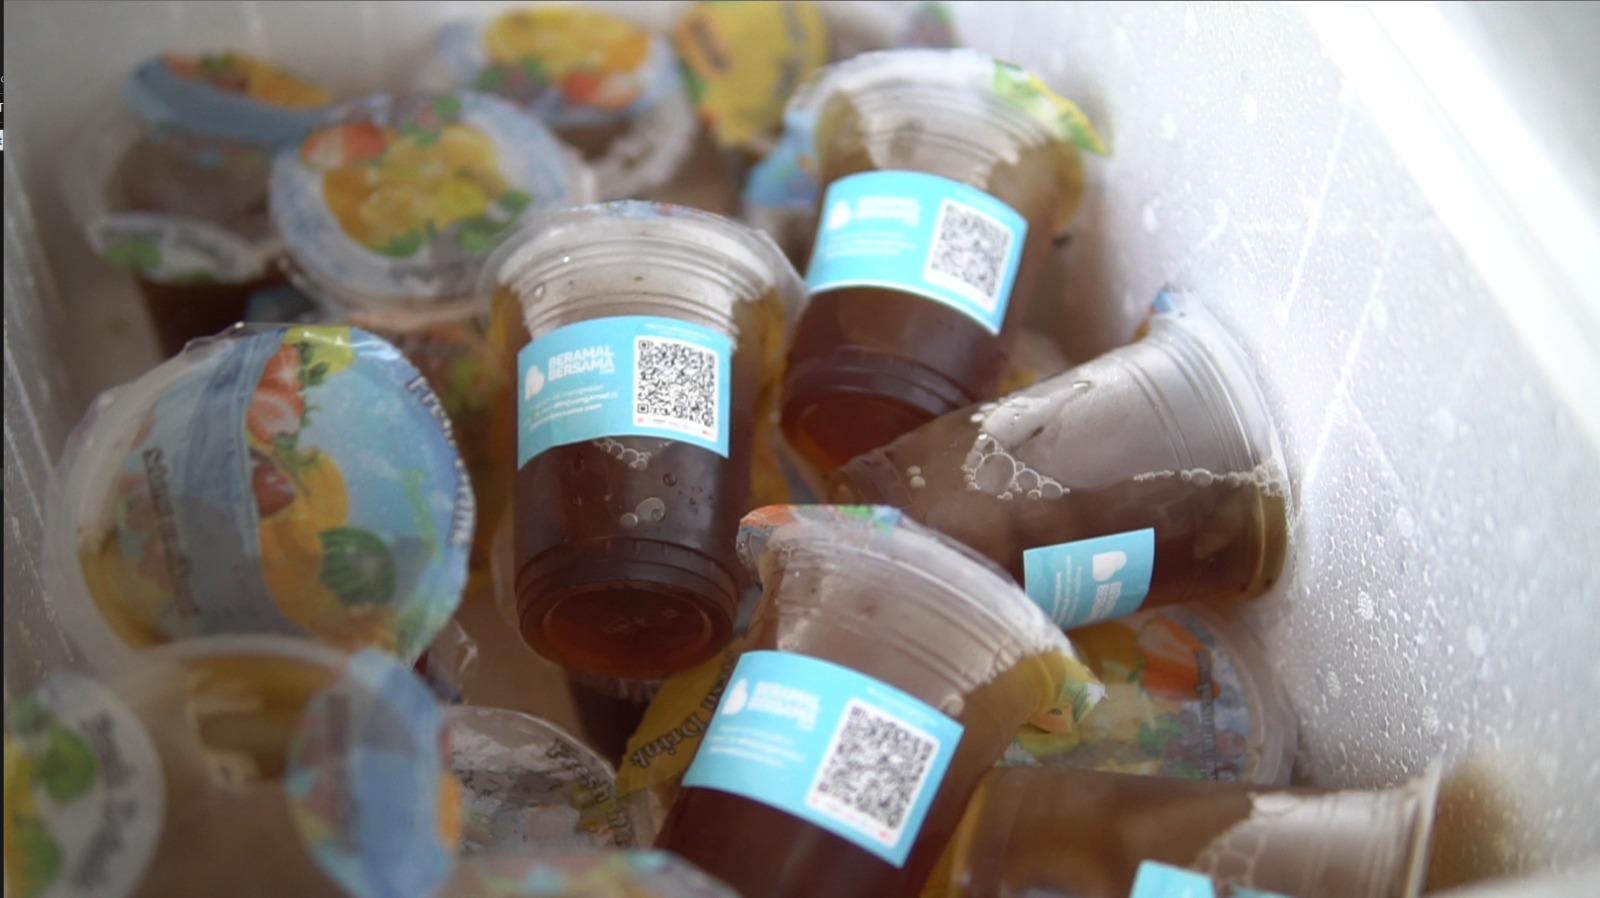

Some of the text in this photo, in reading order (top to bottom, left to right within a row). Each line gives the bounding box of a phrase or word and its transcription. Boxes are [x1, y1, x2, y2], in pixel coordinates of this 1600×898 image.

[548, 345, 615, 369] BERAMAL
[548, 357, 615, 381] BERSAMA
[630, 712, 706, 769] Drink
